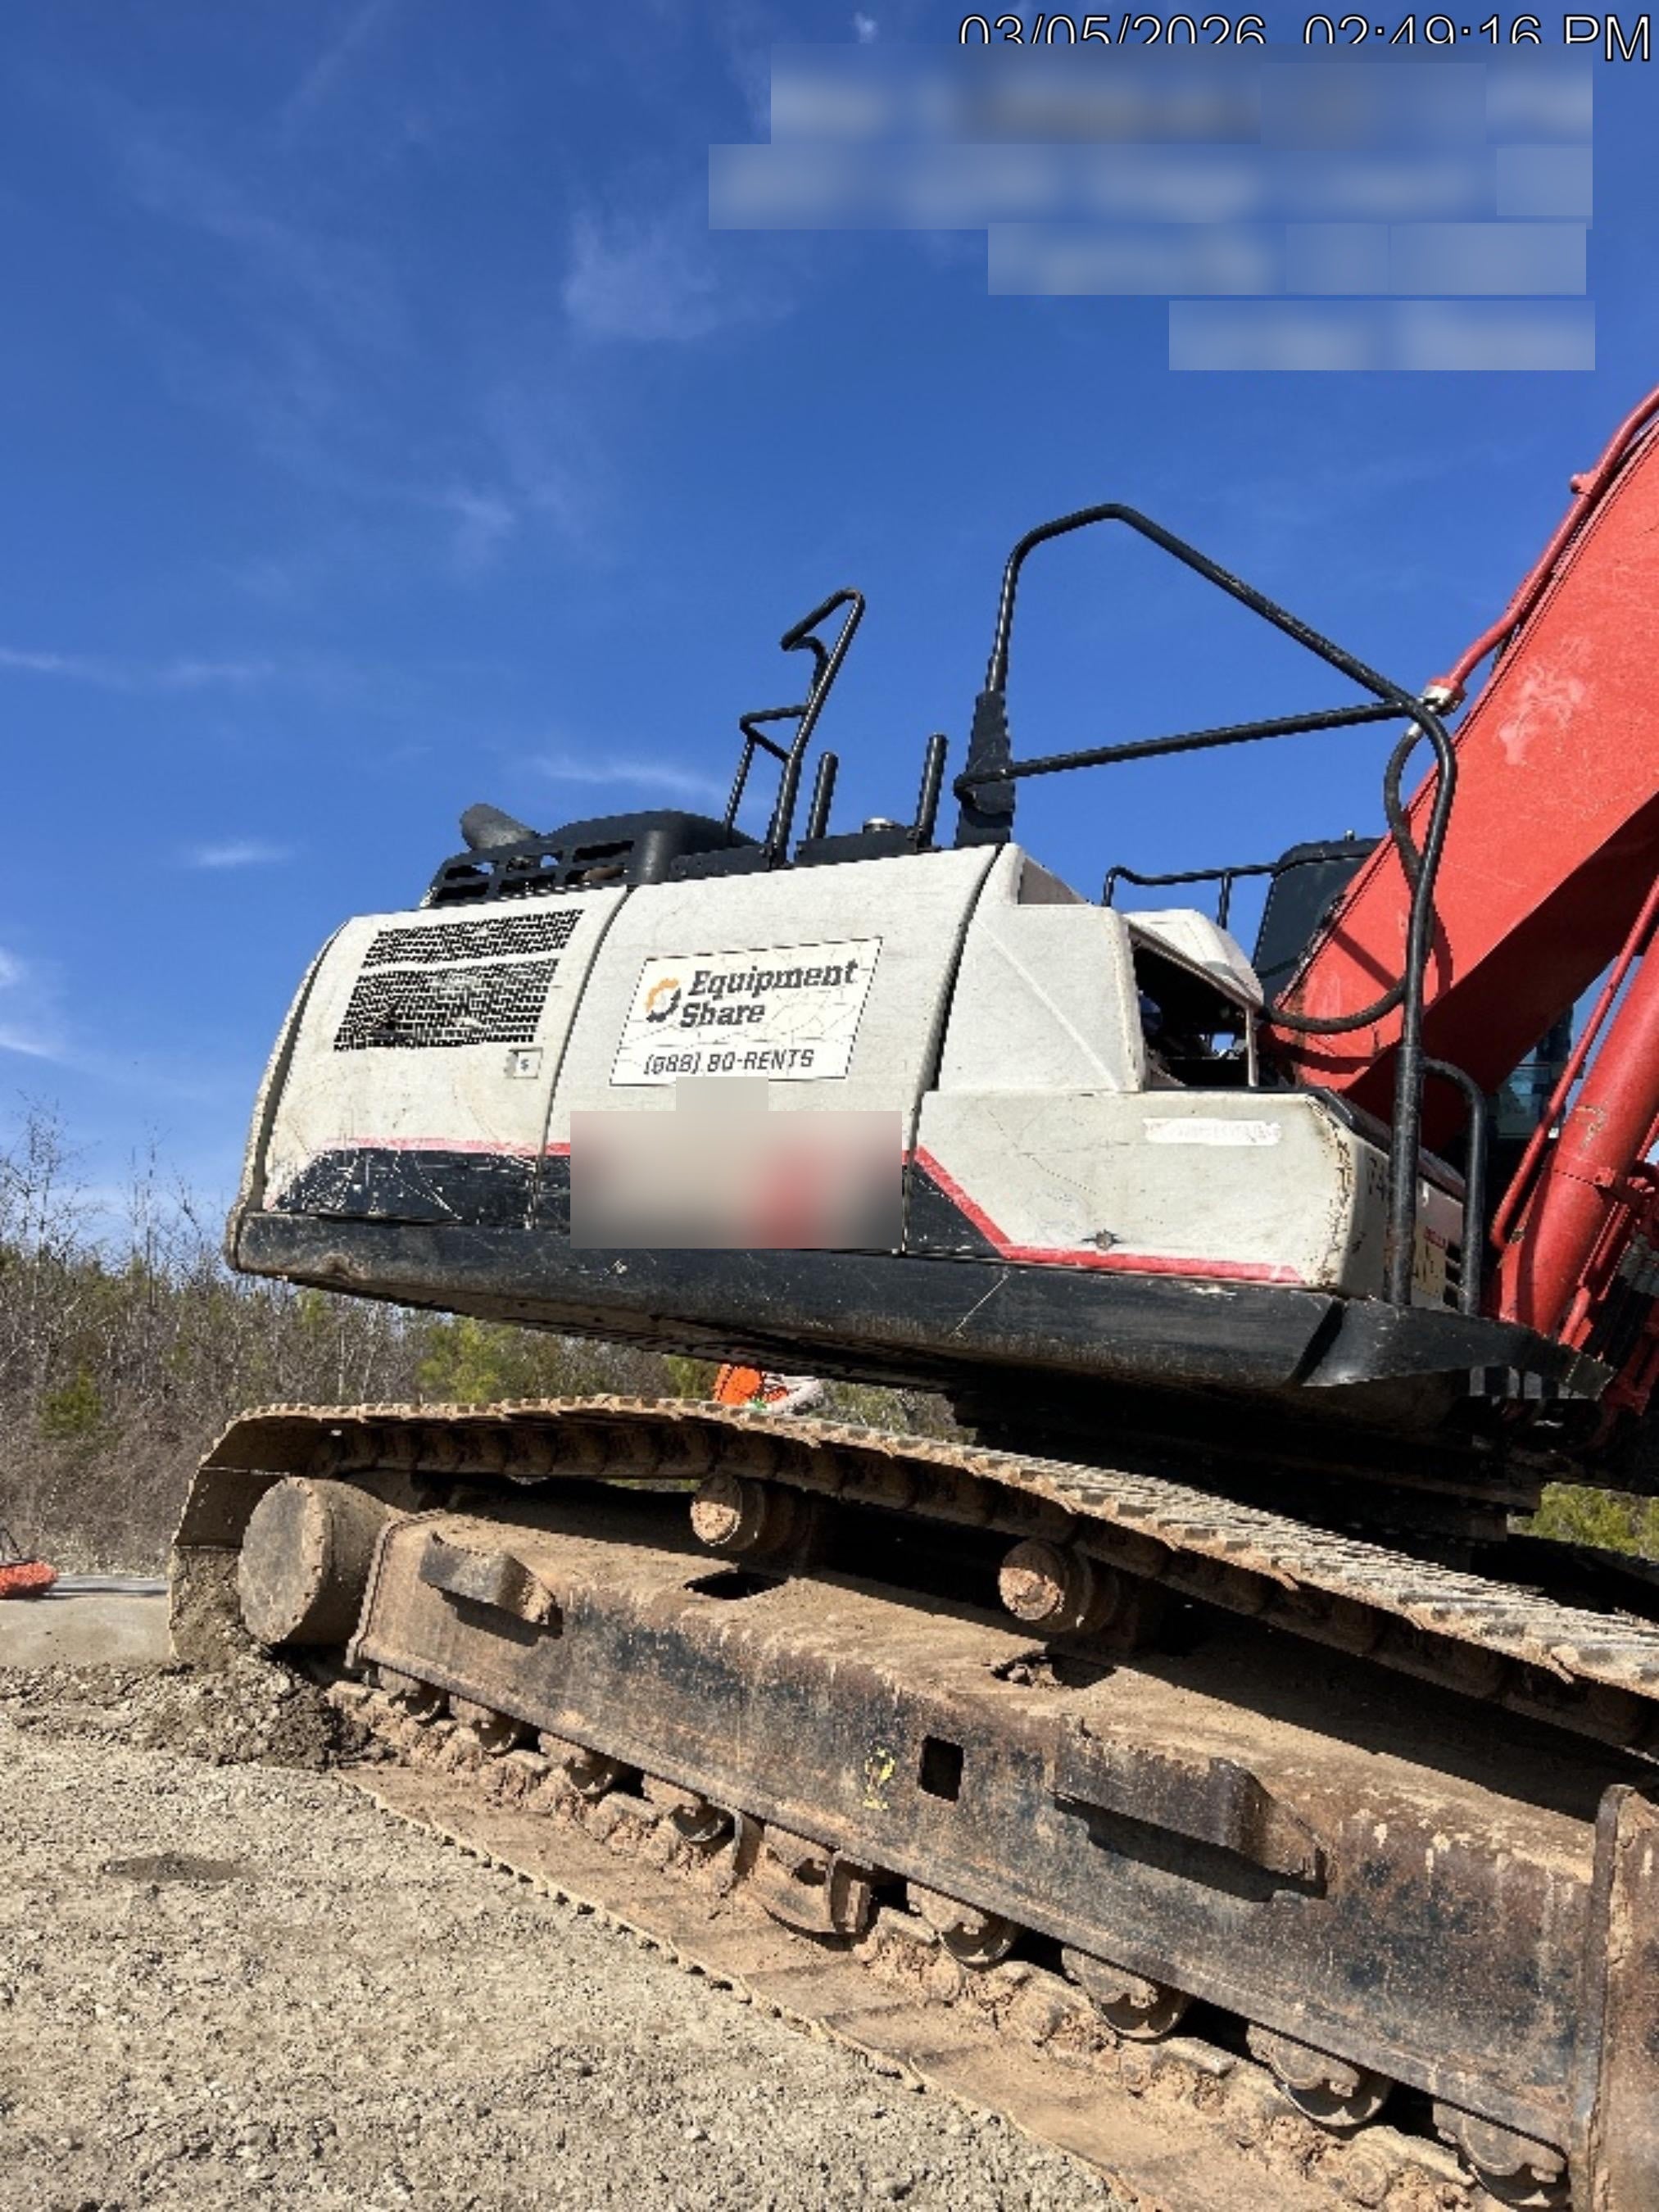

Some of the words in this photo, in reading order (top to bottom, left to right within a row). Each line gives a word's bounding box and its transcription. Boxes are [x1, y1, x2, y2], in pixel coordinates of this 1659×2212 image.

[687, 959, 859, 1000] Equipment
[680, 1001, 765, 1027] Share
[643, 1050, 701, 1075] (888)
